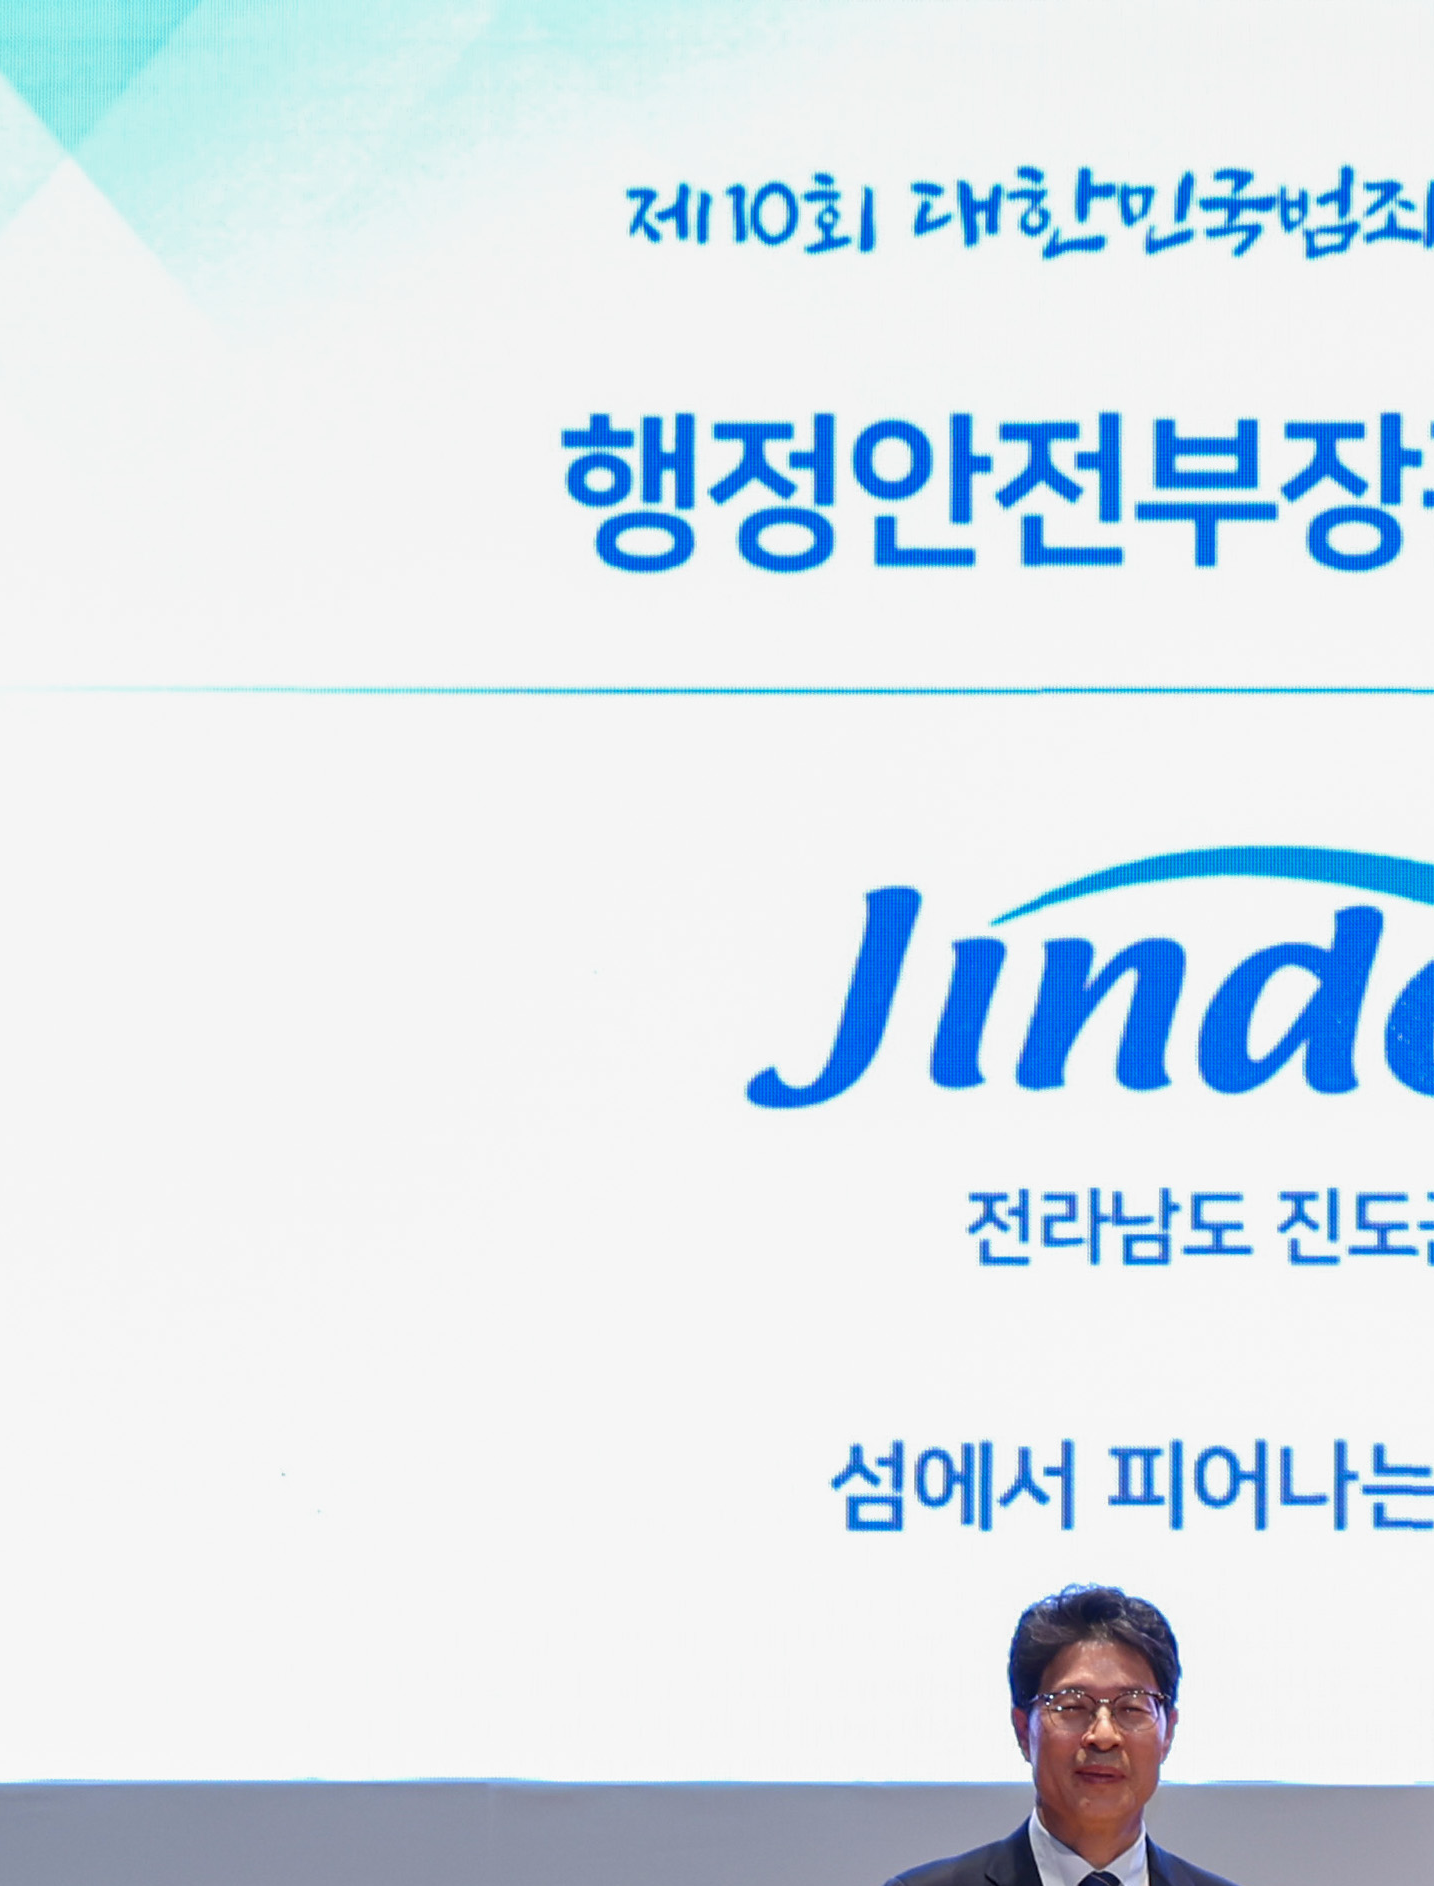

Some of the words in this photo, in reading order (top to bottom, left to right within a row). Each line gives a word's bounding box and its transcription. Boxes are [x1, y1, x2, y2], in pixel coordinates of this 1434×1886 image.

[625, 169, 878, 257] 제10회
[966, 1187, 1255, 1268] 전라남도
[829, 1438, 1076, 1533] 섬에서
